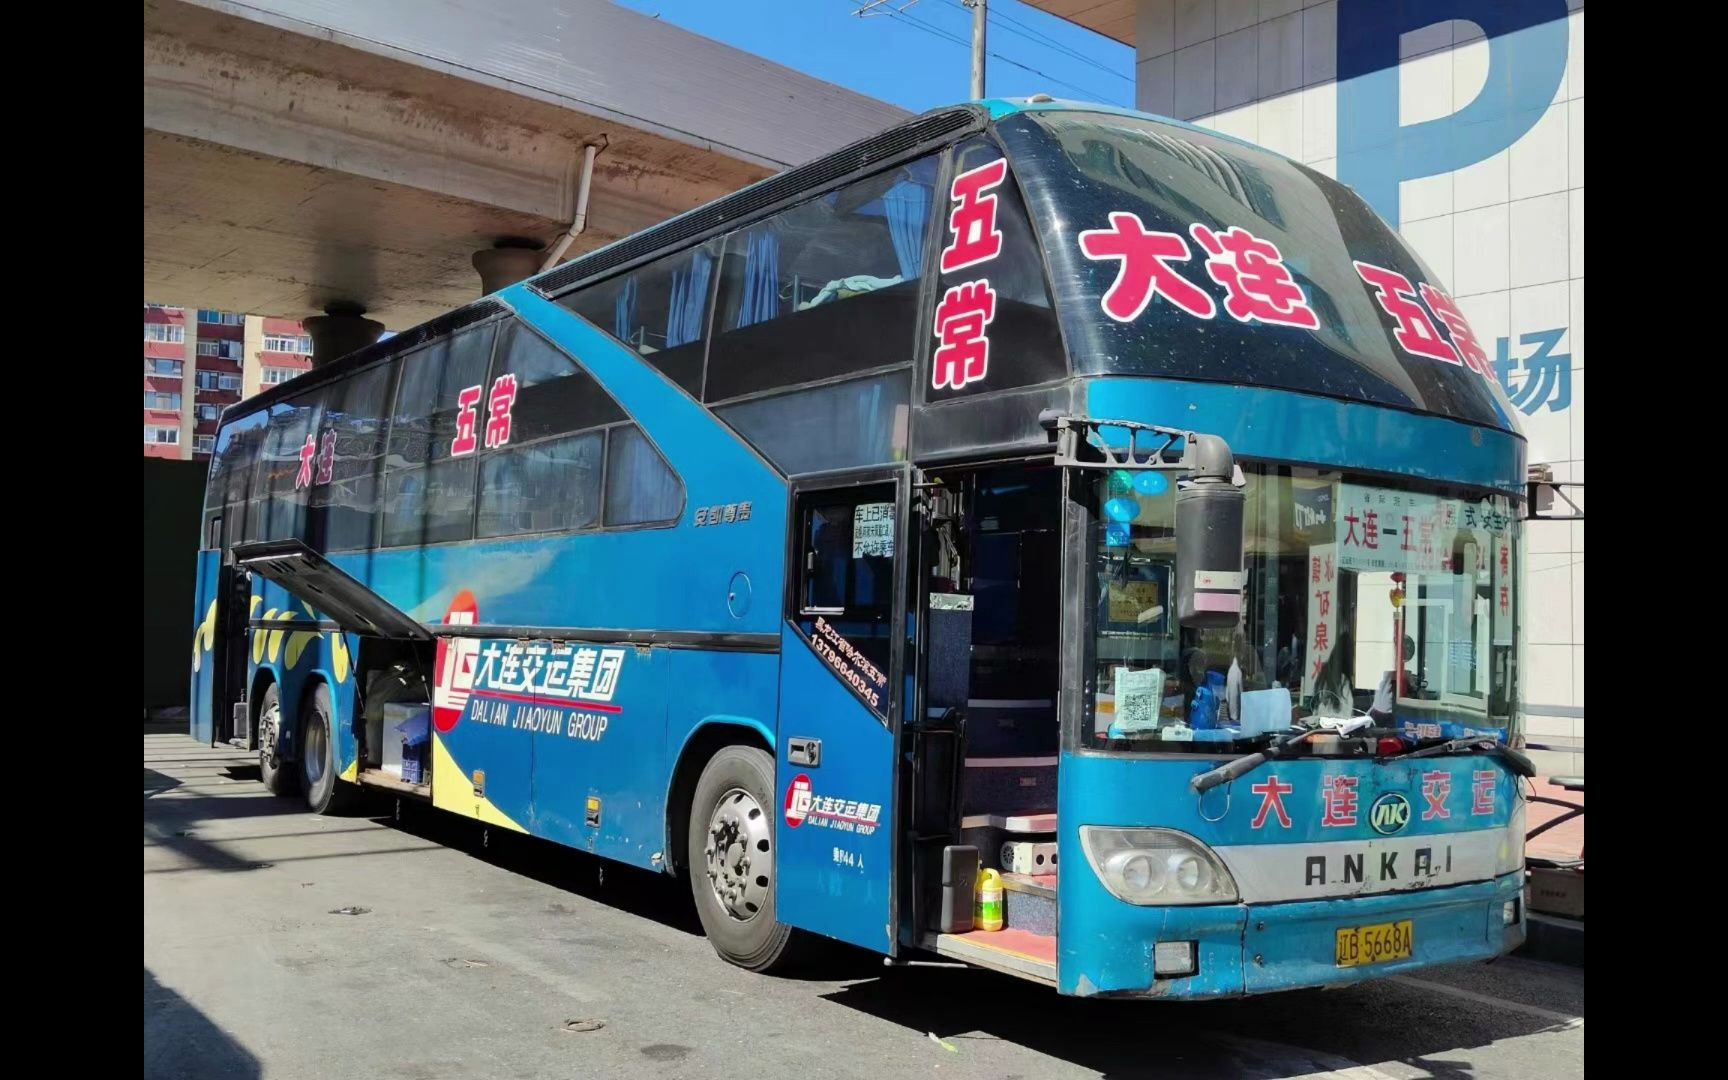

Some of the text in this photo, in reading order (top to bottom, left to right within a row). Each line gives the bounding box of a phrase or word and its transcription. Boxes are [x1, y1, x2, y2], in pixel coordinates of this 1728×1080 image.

[1336, 0, 1570, 231] P
[932, 157, 1007, 390] 五常
[1078, 211, 1498, 384] 大连 五常
[1488, 326, 1572, 417] 场
[451, 373, 517, 456] 五常
[295, 430, 337, 489] 大连
[475, 642, 626, 702] 大连交运集团
[811, 634, 879, 707] 13796640345
[471, 700, 608, 742] DALIAN JIAOYUN GROUP
[808, 815, 876, 835] DALIAN JIAOYUN GROUP
[810, 795, 882, 823] 大连交运集团
[1305, 845, 1452, 886] ANKAI
